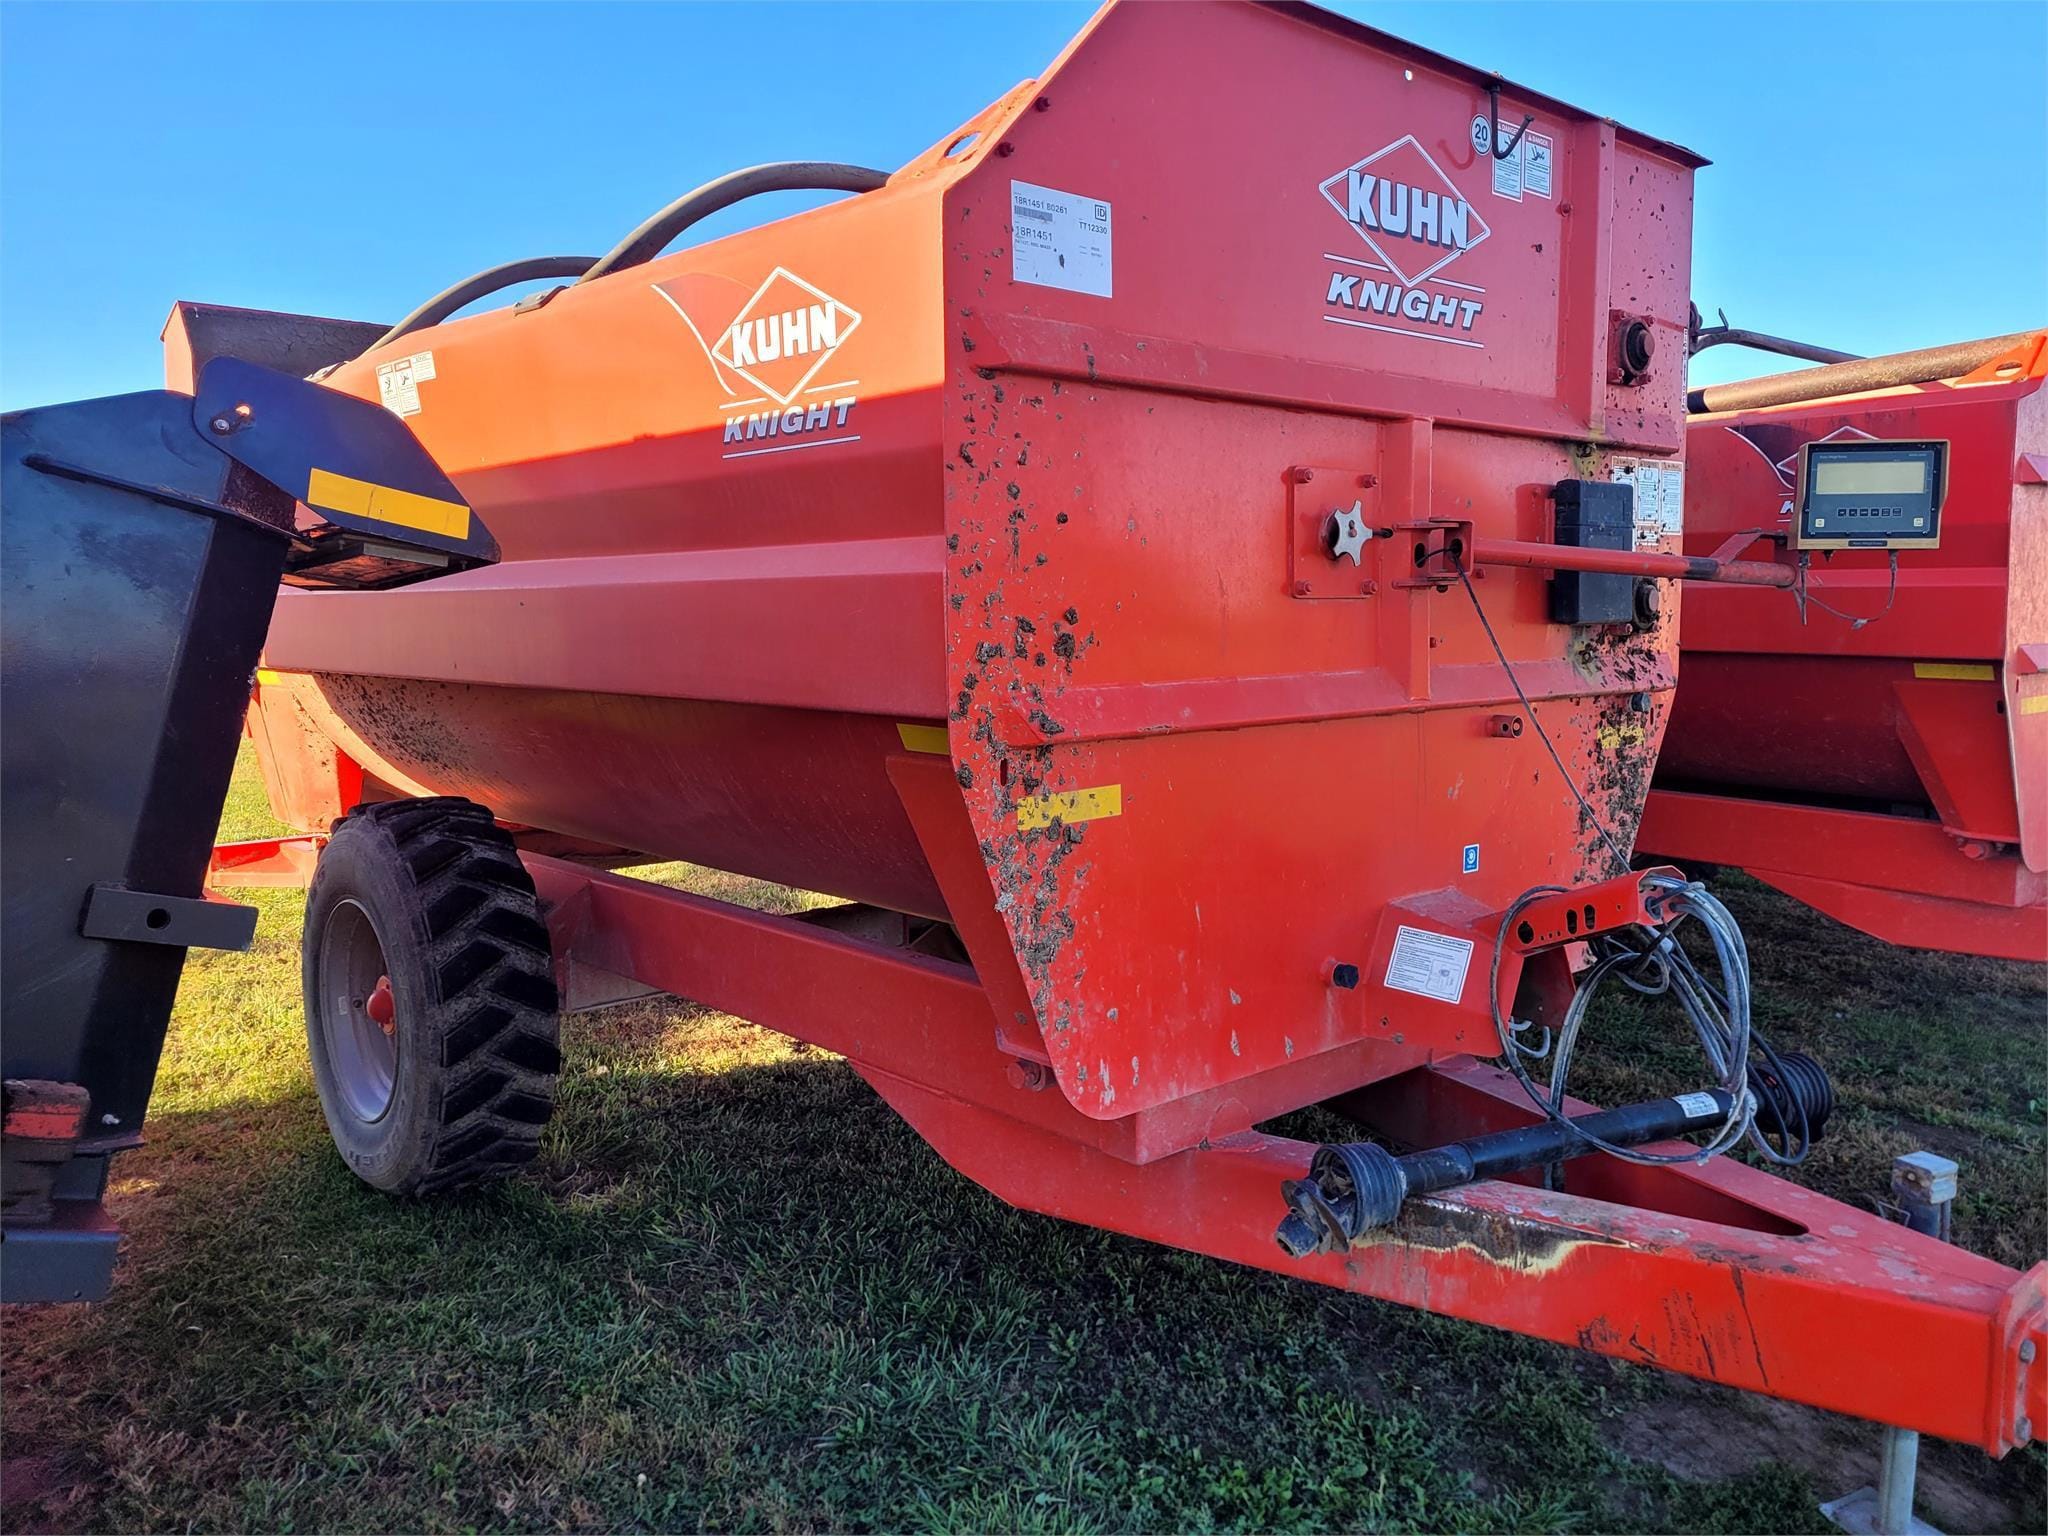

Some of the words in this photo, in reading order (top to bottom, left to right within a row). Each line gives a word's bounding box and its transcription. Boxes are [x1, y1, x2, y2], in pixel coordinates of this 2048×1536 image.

[1475, 123, 1488, 142] 20
[1014, 195, 1044, 209] 18R1451
[1348, 169, 1468, 250] KUHN
[1015, 226, 1053, 241] 18R1451
[1078, 221, 1108, 235] TT12330
[1325, 271, 1483, 330] KNIGHT
[731, 301, 837, 368] KUHN
[723, 397, 856, 443] KNIGHT
